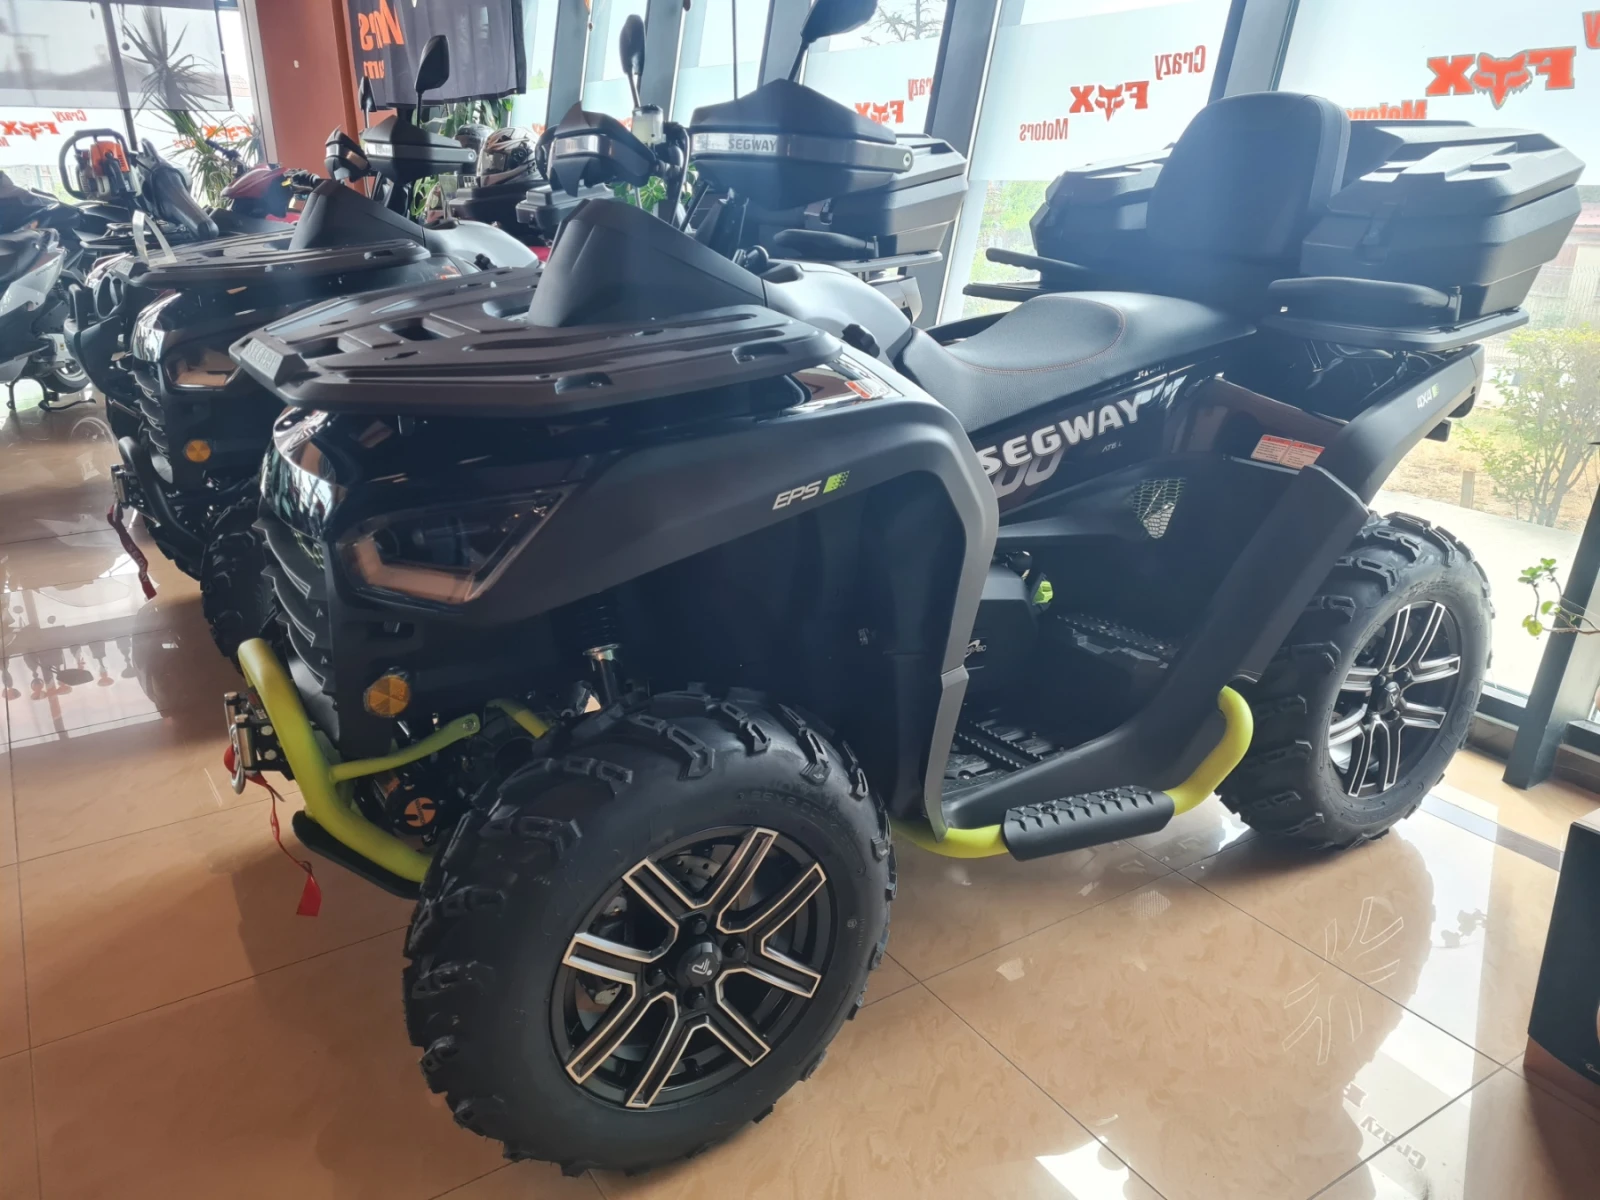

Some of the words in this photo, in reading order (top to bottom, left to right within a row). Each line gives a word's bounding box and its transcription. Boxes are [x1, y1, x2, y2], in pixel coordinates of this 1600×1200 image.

[728, 139, 777, 151] SEGWAY
[976, 399, 1141, 477] SEGWAY
[772, 480, 822, 510] EPS
